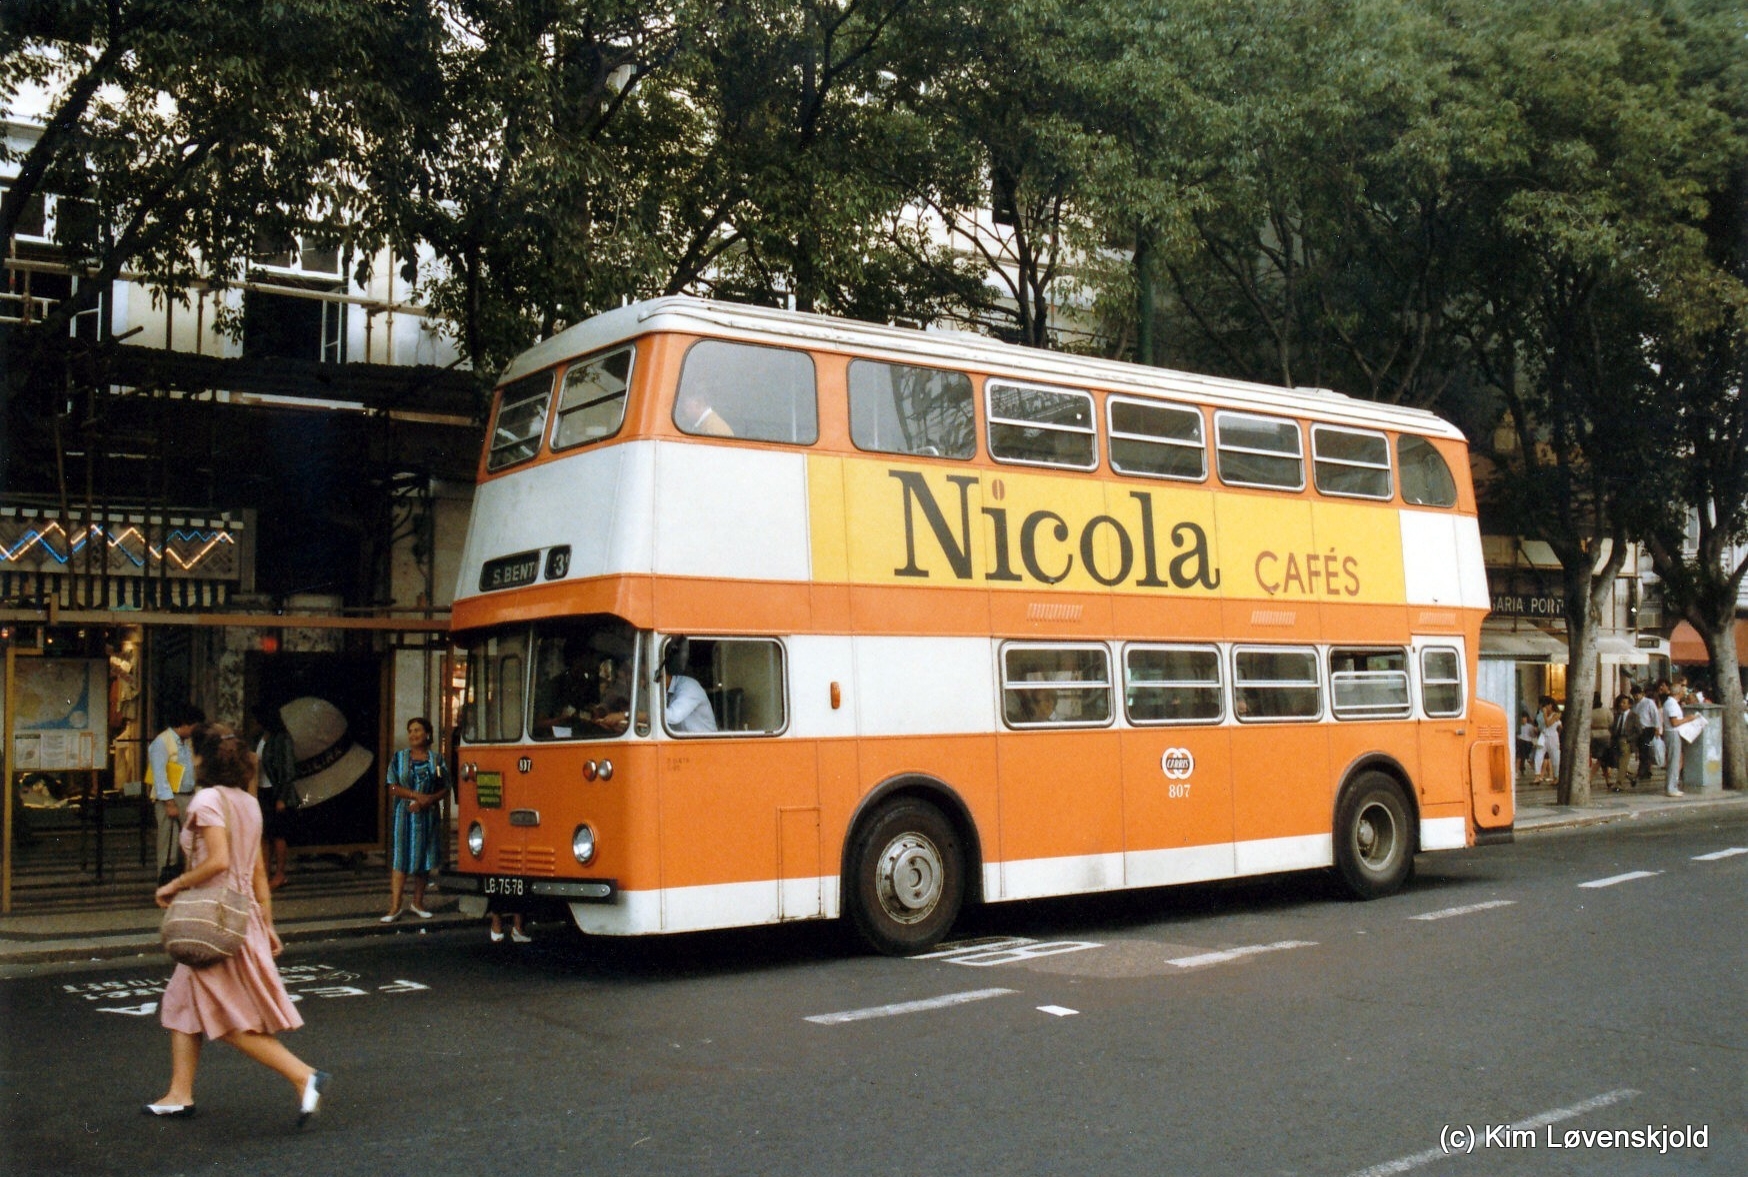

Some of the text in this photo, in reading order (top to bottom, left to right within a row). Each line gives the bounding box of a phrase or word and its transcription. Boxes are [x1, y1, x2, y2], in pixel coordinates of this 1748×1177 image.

[888, 469, 1220, 591] Nicola
[503, 561, 537, 583] BENT
[1254, 547, 1361, 597] CAFÉS
[1168, 784, 1191, 799] 807
